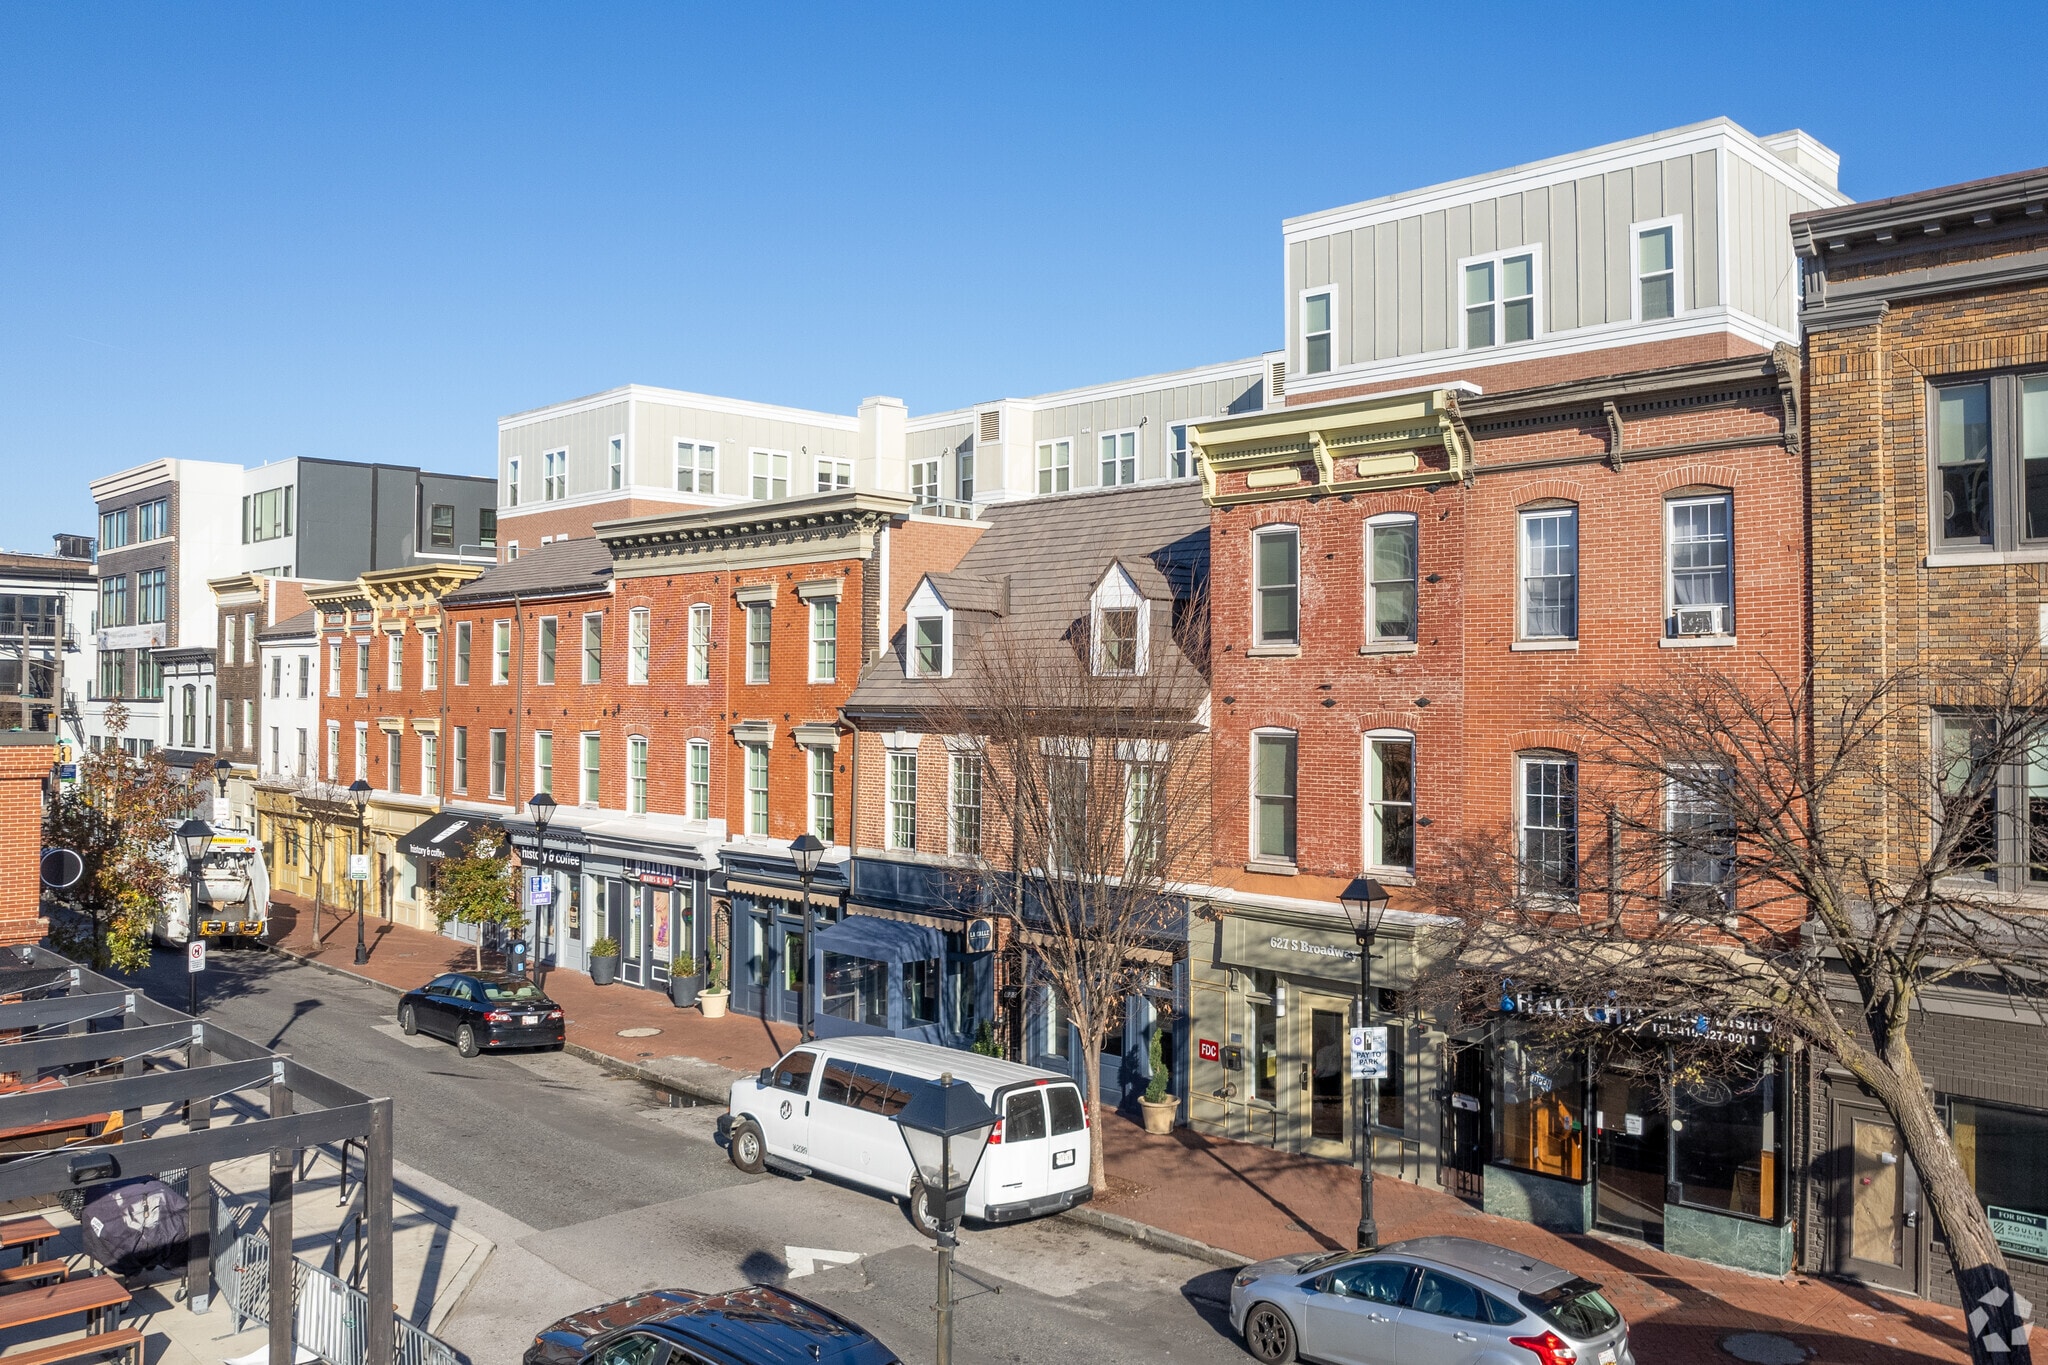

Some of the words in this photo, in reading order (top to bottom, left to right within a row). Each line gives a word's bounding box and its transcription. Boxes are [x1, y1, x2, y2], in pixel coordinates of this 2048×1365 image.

[410, 844, 426, 857] history
[521, 846, 548, 864] histoy
[549, 850, 555, 862] &
[555, 852, 580, 866] coffee
[1270, 937, 1289, 950] 627
[1291, 939, 1299, 951] S
[1201, 1043, 1217, 1057] FDC
[1532, 1074, 1551, 1089] OPEN
[1690, 1083, 1725, 1101] OPEN
[1998, 1211, 2015, 1221] FOR
[2016, 1214, 2038, 1225] RENT
[2007, 1225, 2043, 1237] ZOULIS
[2007, 1231, 2044, 1242] PROPERTIES
